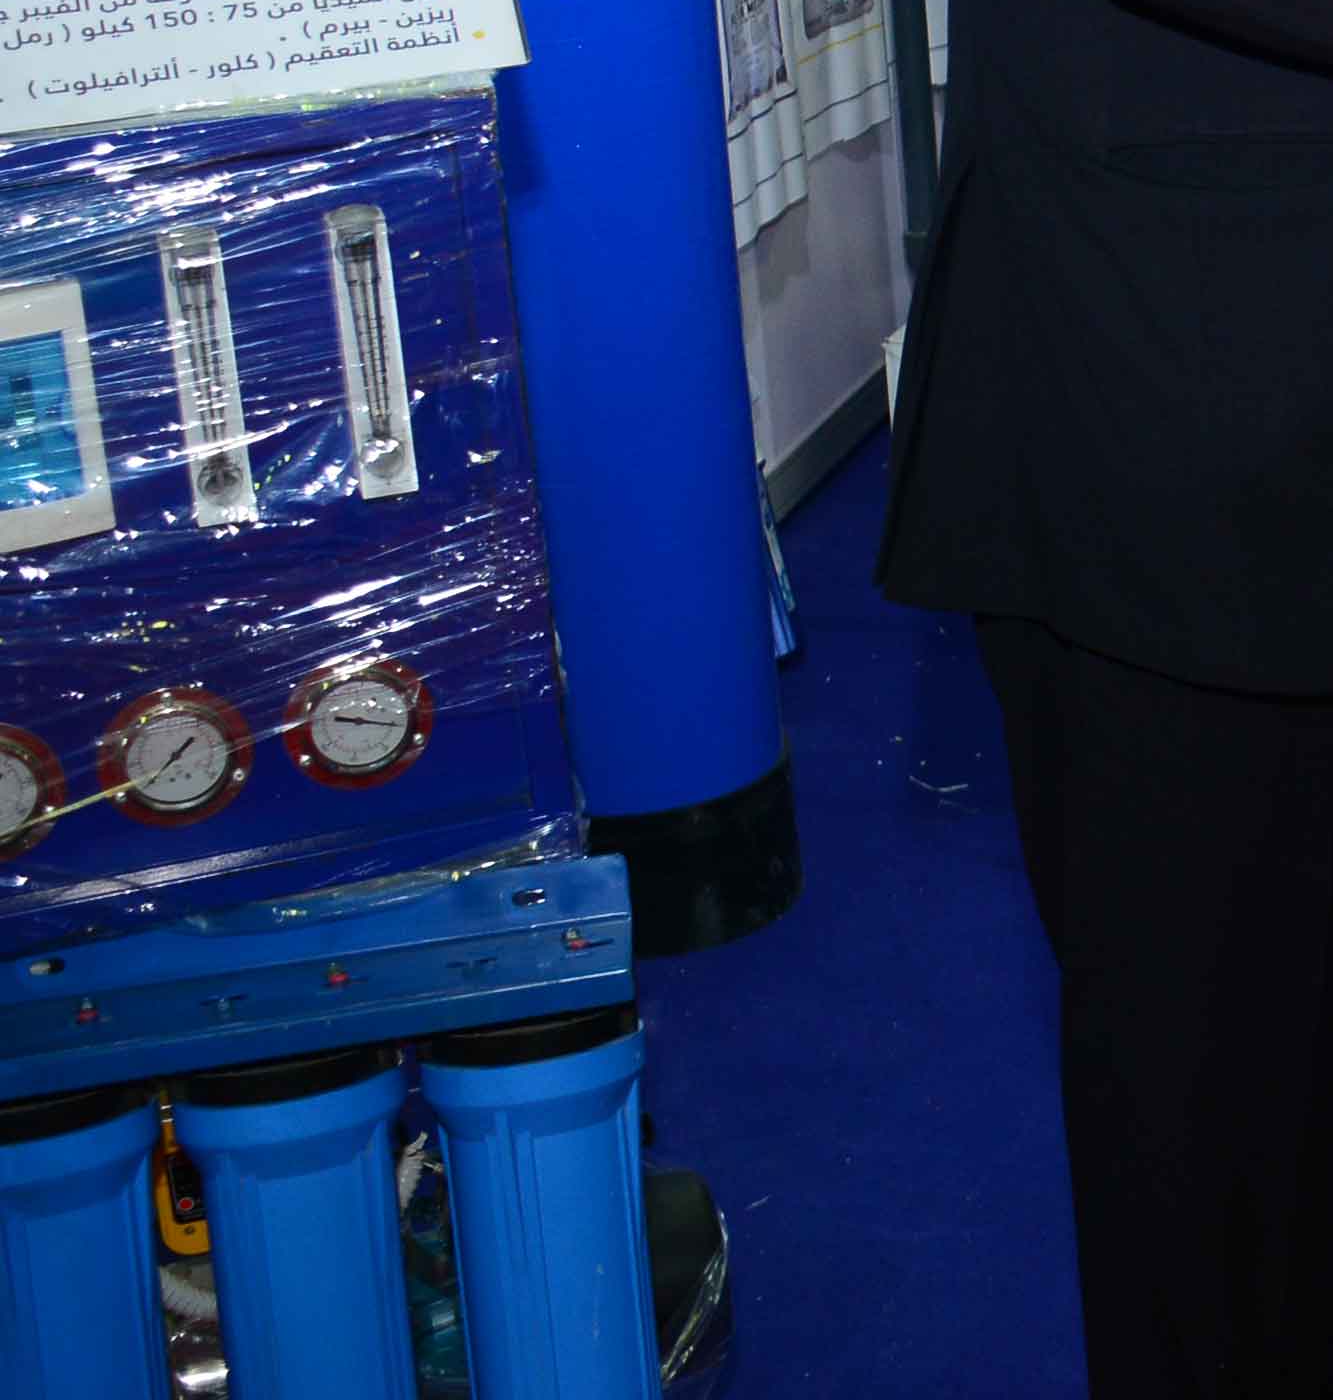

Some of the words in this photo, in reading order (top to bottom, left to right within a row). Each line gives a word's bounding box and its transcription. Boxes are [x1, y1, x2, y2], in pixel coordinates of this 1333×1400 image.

[145, 9, 198, 30] 150
[223, 1, 258, 22] 75
[267, 1, 304, 20] من
[81, 16, 136, 42] كيلو
[387, 21, 460, 51] أنظمة
[207, 53, 259, 79] كلور
[284, 37, 379, 73] التعقيم
